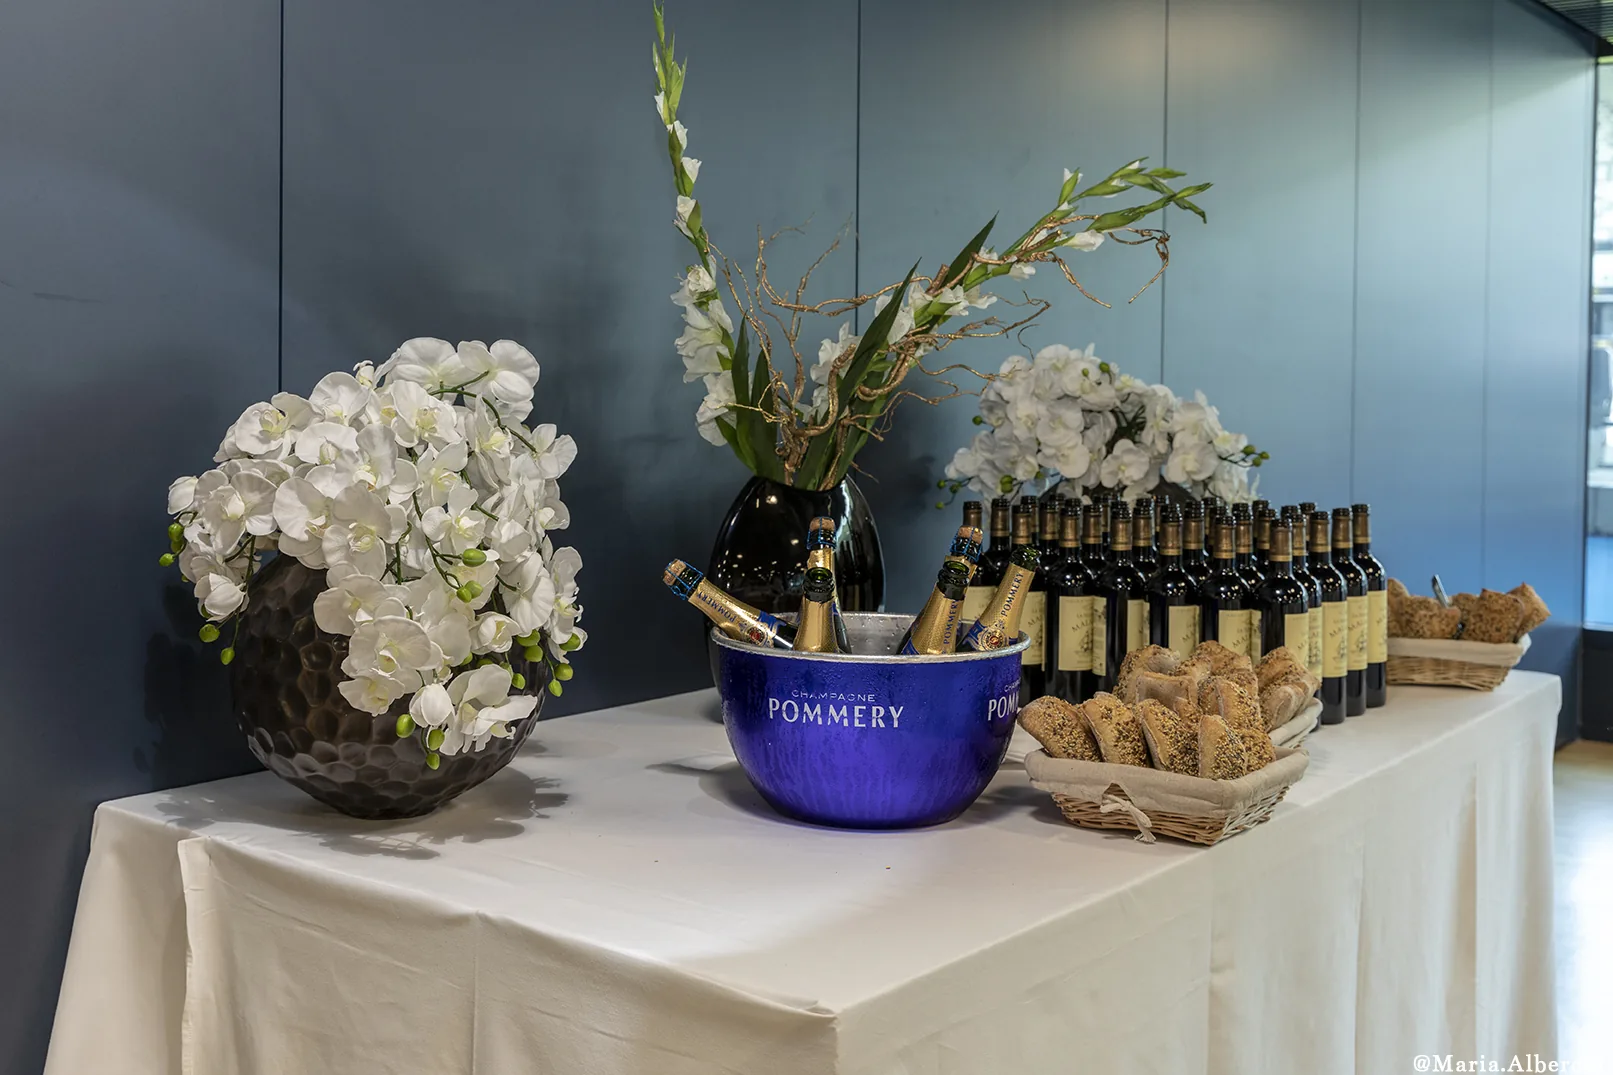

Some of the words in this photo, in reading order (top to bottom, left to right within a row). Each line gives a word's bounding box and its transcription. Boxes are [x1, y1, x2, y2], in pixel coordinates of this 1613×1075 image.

[696, 591, 737, 623] POMMERY
[1000, 572, 1024, 617] POMMERY
[791, 689, 876, 702] CHAMPAGNE
[768, 697, 904, 728] POMMERY
